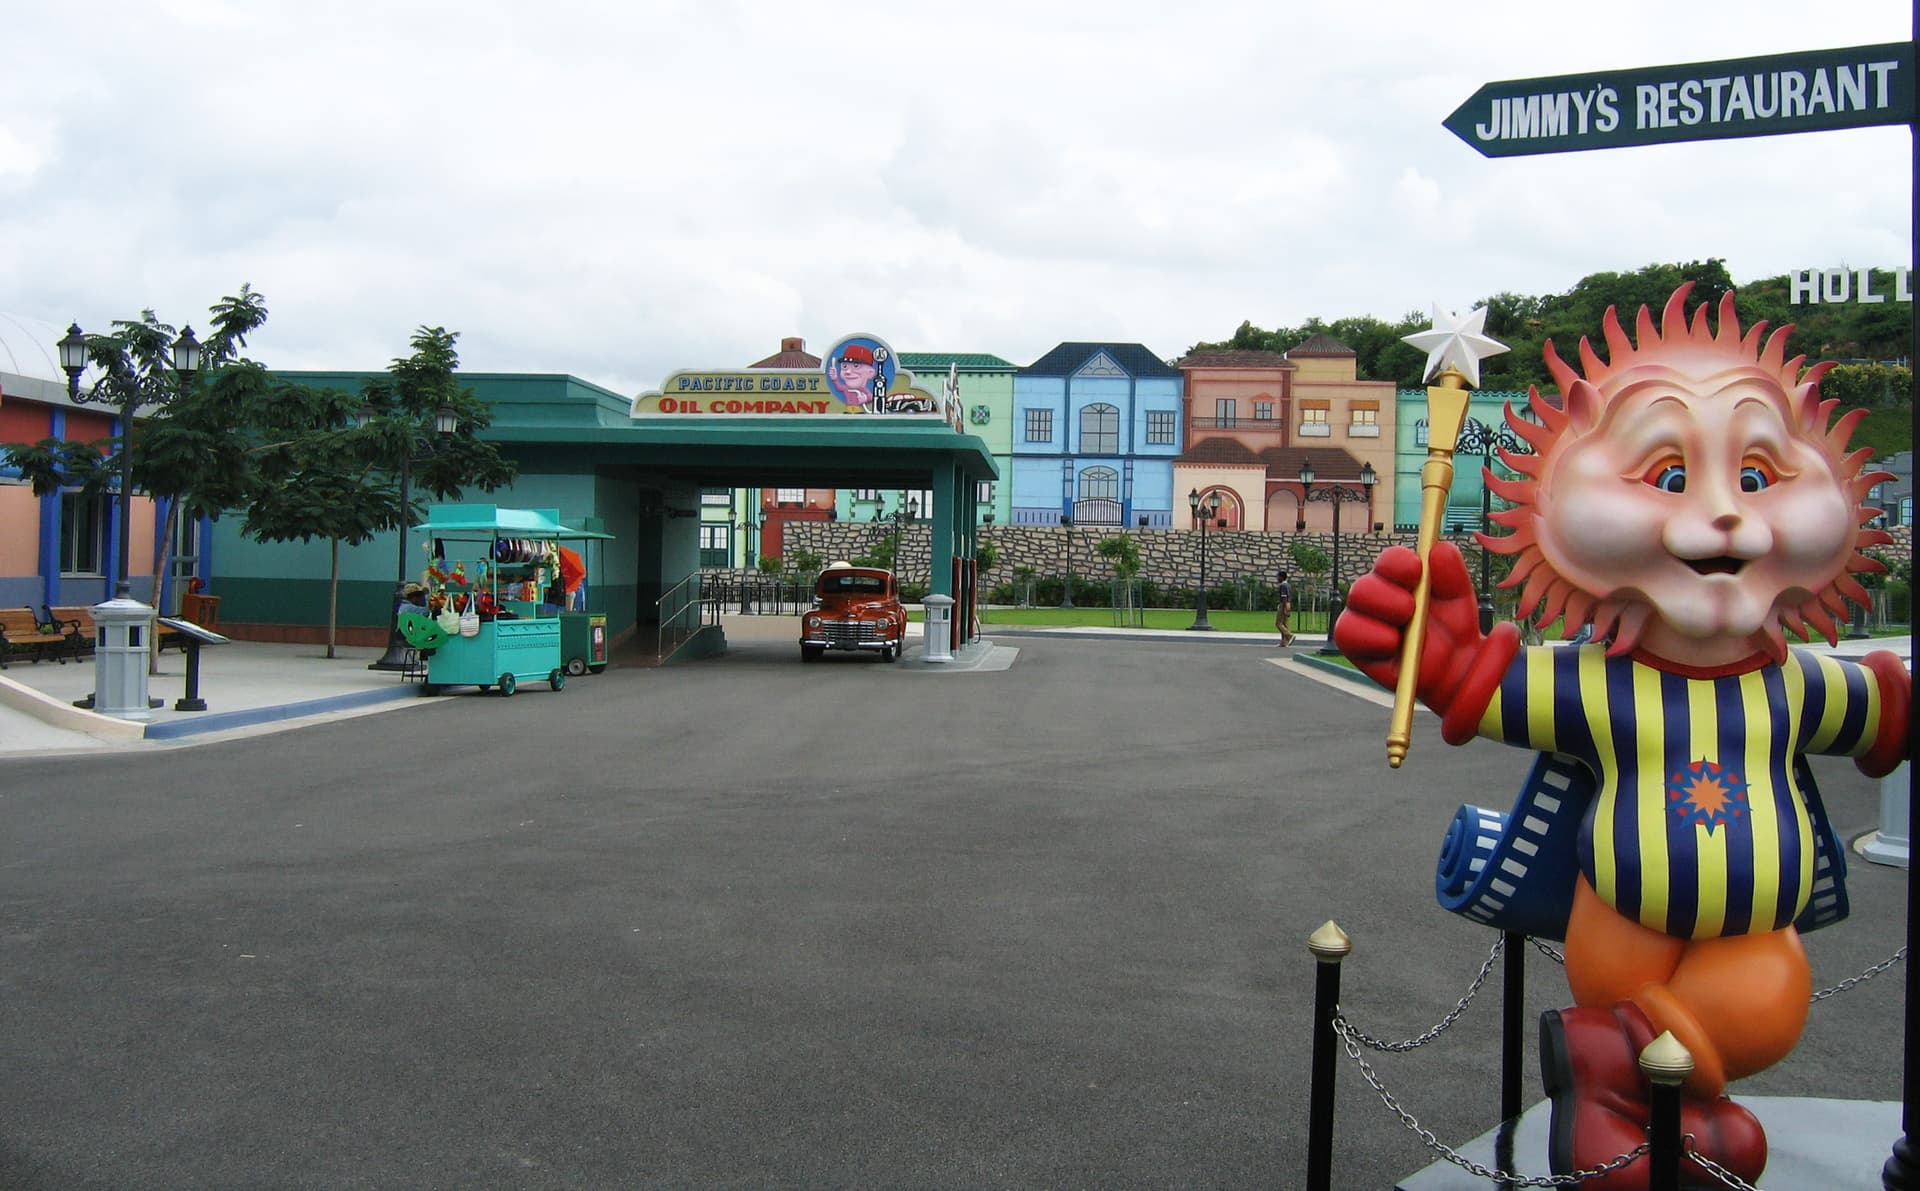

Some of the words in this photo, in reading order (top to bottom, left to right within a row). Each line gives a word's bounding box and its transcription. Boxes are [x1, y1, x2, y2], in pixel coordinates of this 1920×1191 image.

[1475, 83, 1620, 141] JIMMY'S
[1636, 60, 1898, 130] RESTAURANT
[678, 377, 754, 391] PACIFIC
[760, 377, 820, 391] COAST
[658, 397, 703, 414] OIL
[709, 400, 831, 414] COMPANY
